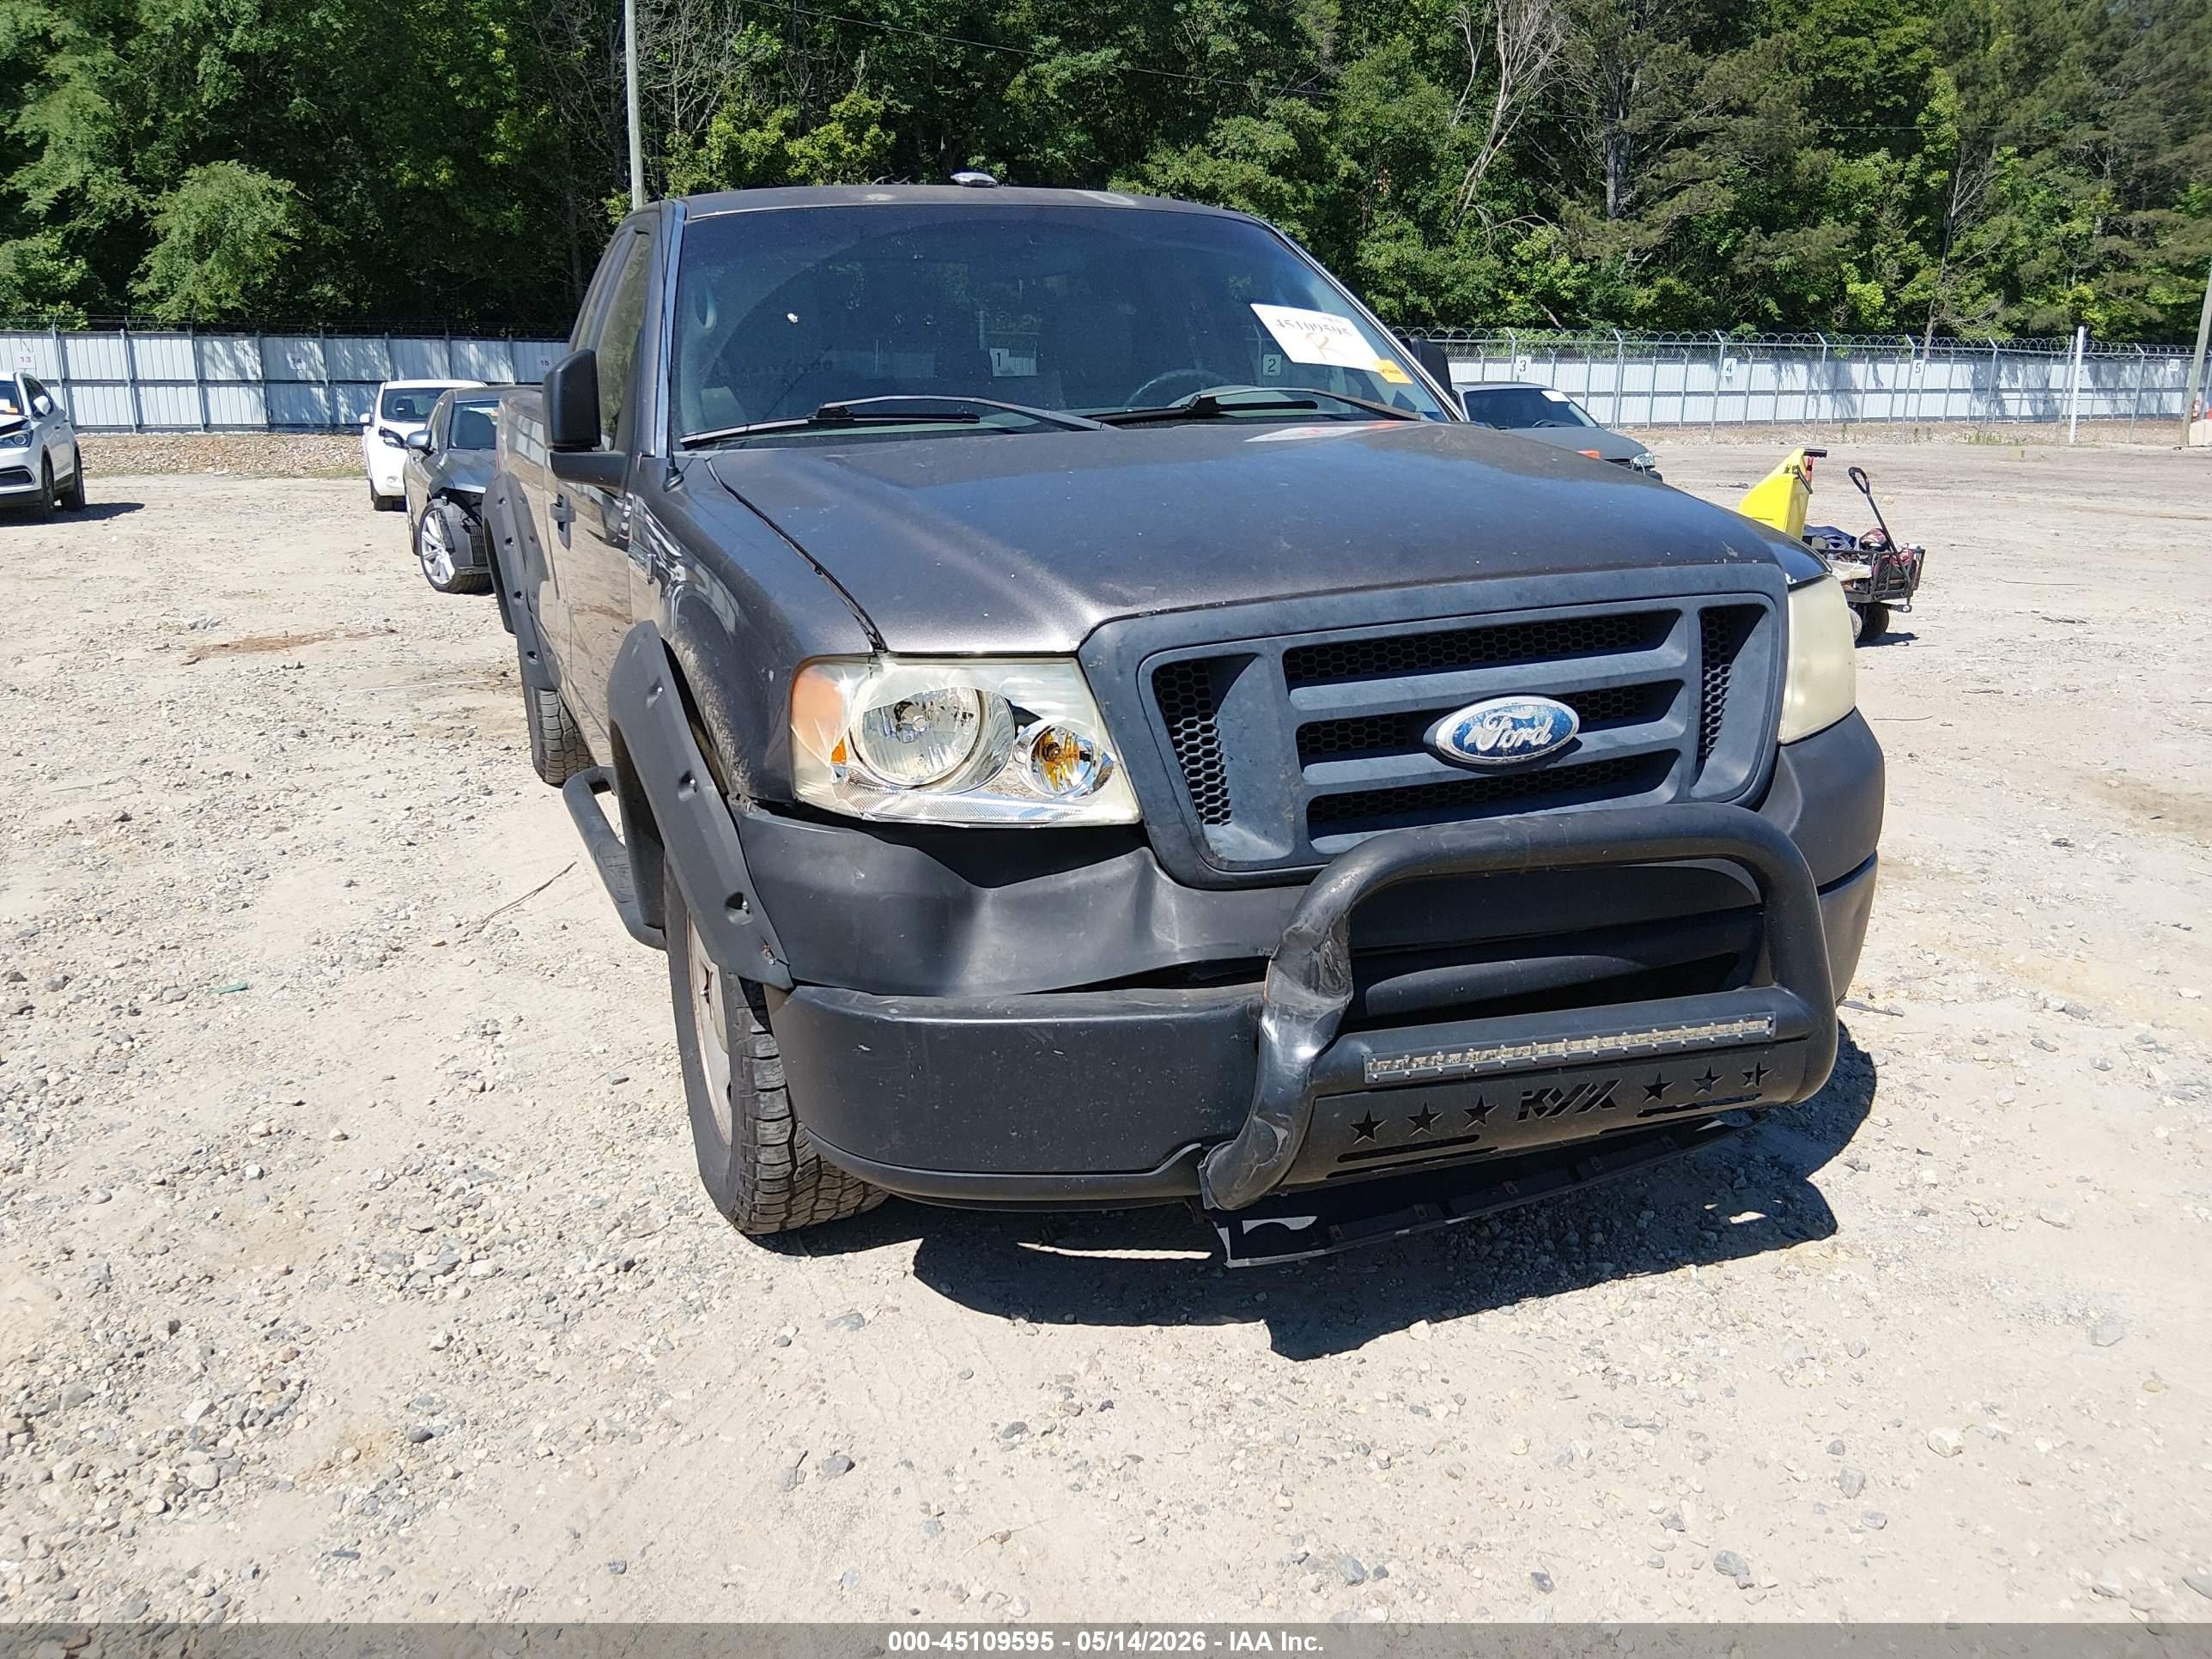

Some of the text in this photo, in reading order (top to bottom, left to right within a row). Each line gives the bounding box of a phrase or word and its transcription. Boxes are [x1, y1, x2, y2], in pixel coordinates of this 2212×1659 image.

[996, 352, 1001, 368] 1
[1267, 357, 1276, 372] 2
[1519, 359, 1527, 372] 3
[1726, 361, 1733, 374] 4
[1915, 362, 1922, 374] 5
[1465, 711, 1553, 751] Ford
